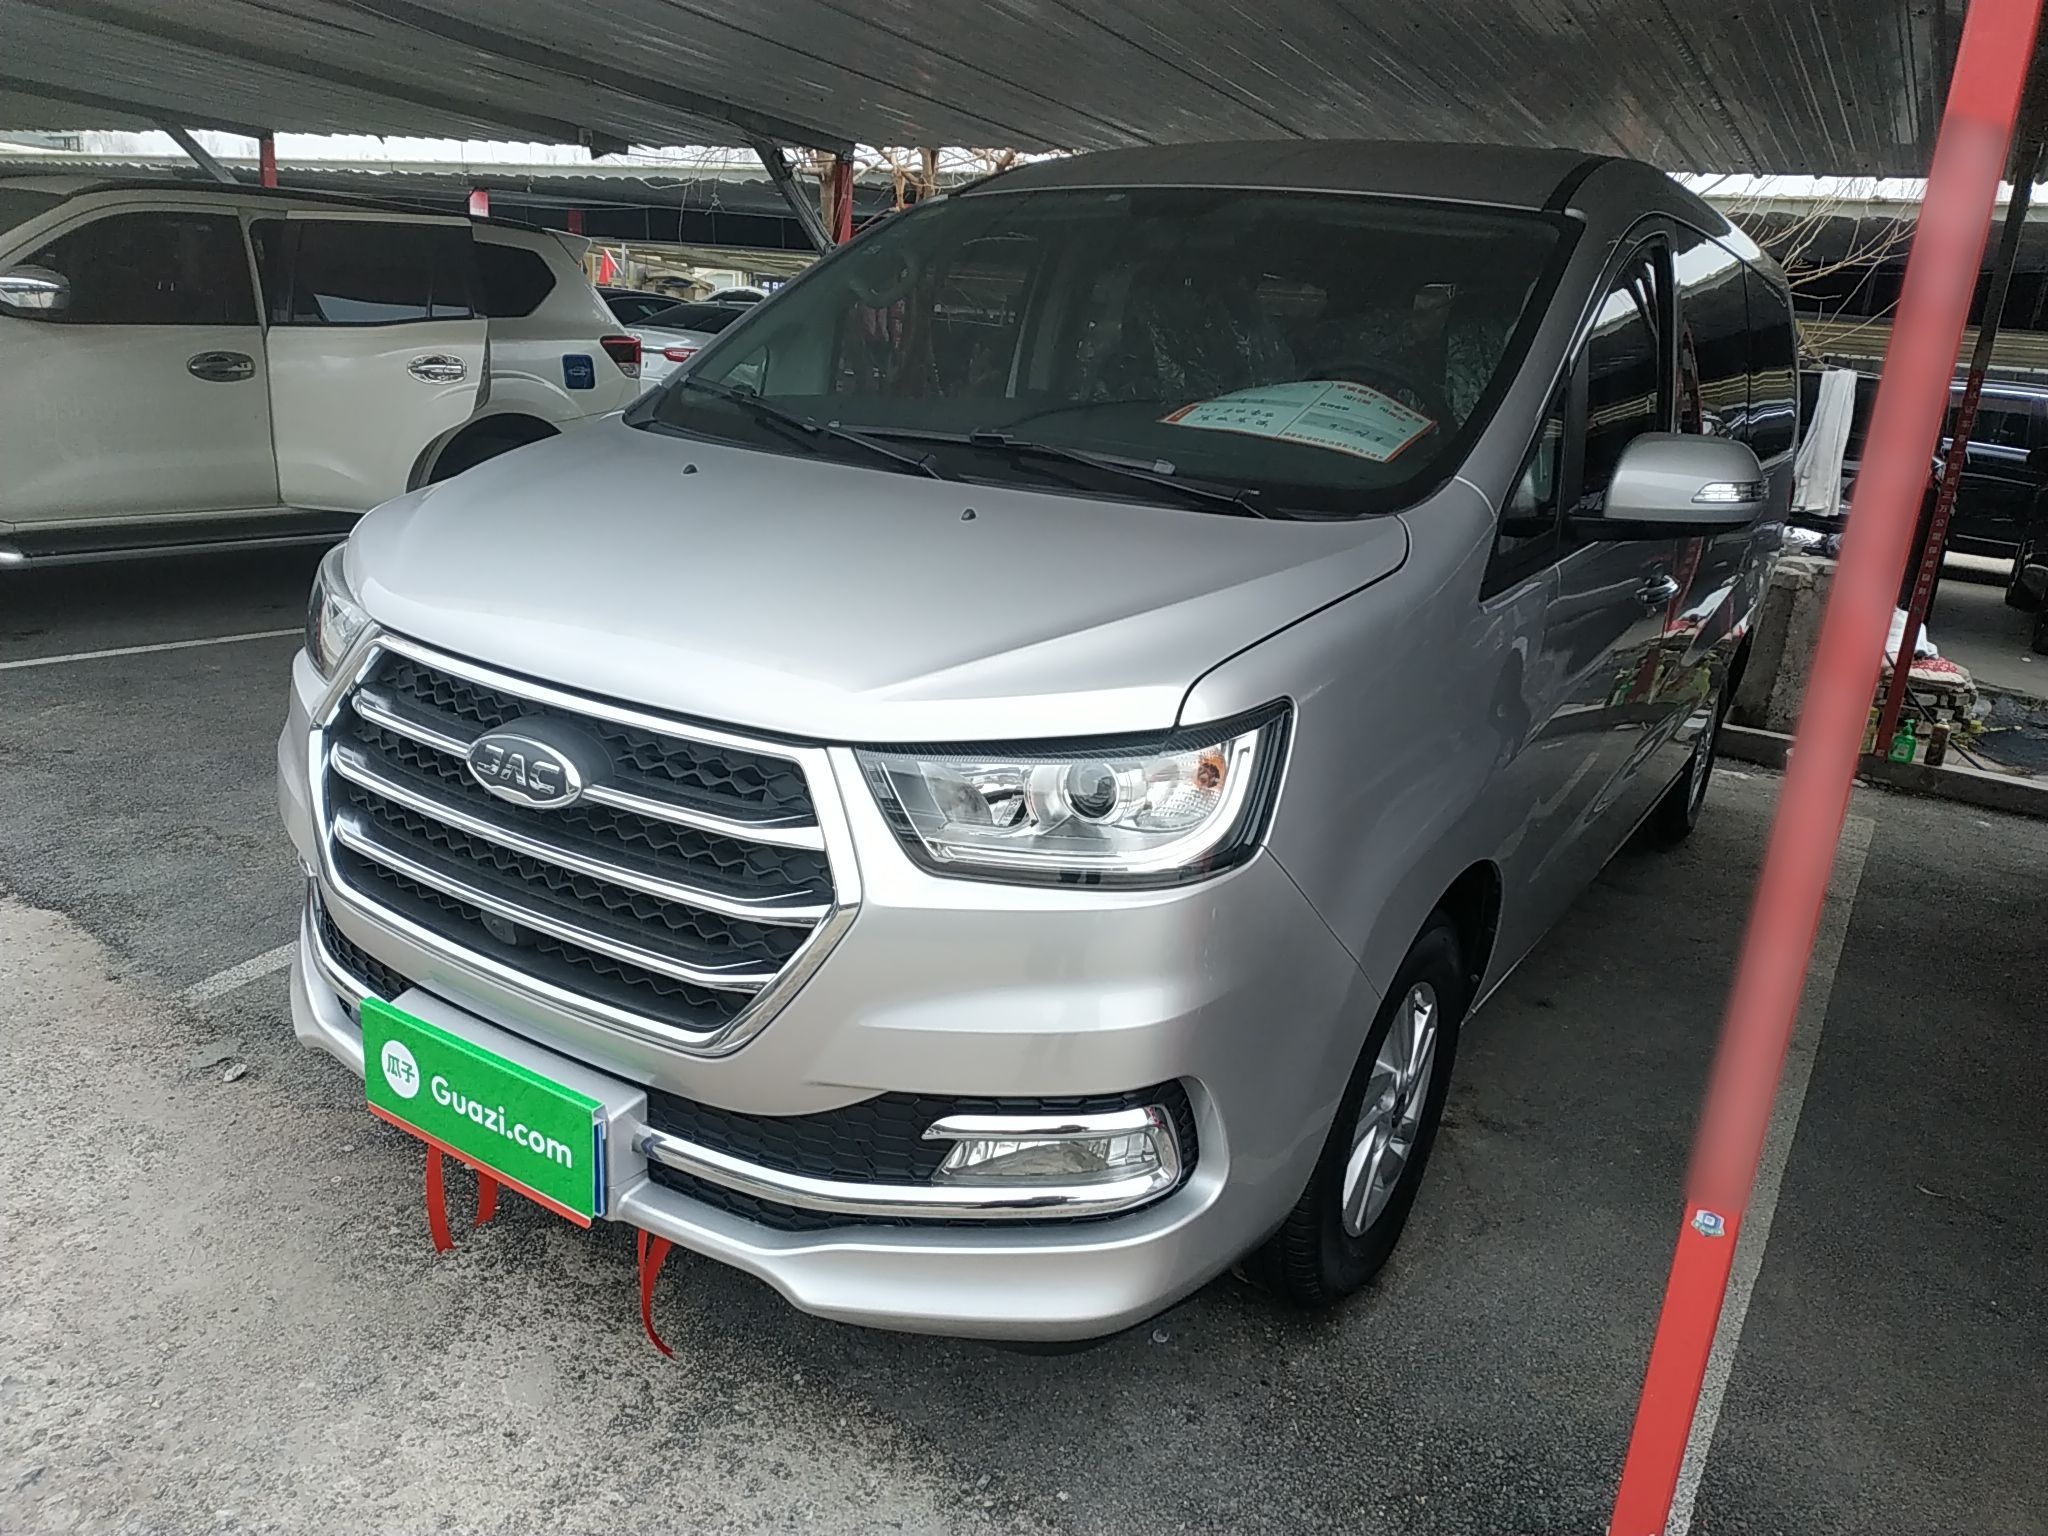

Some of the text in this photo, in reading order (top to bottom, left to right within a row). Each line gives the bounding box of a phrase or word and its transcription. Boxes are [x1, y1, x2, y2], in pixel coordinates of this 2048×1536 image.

[476, 743, 561, 795] JAC
[386, 1052, 416, 1084] 瓜子
[430, 1074, 573, 1169] Guazi.com
